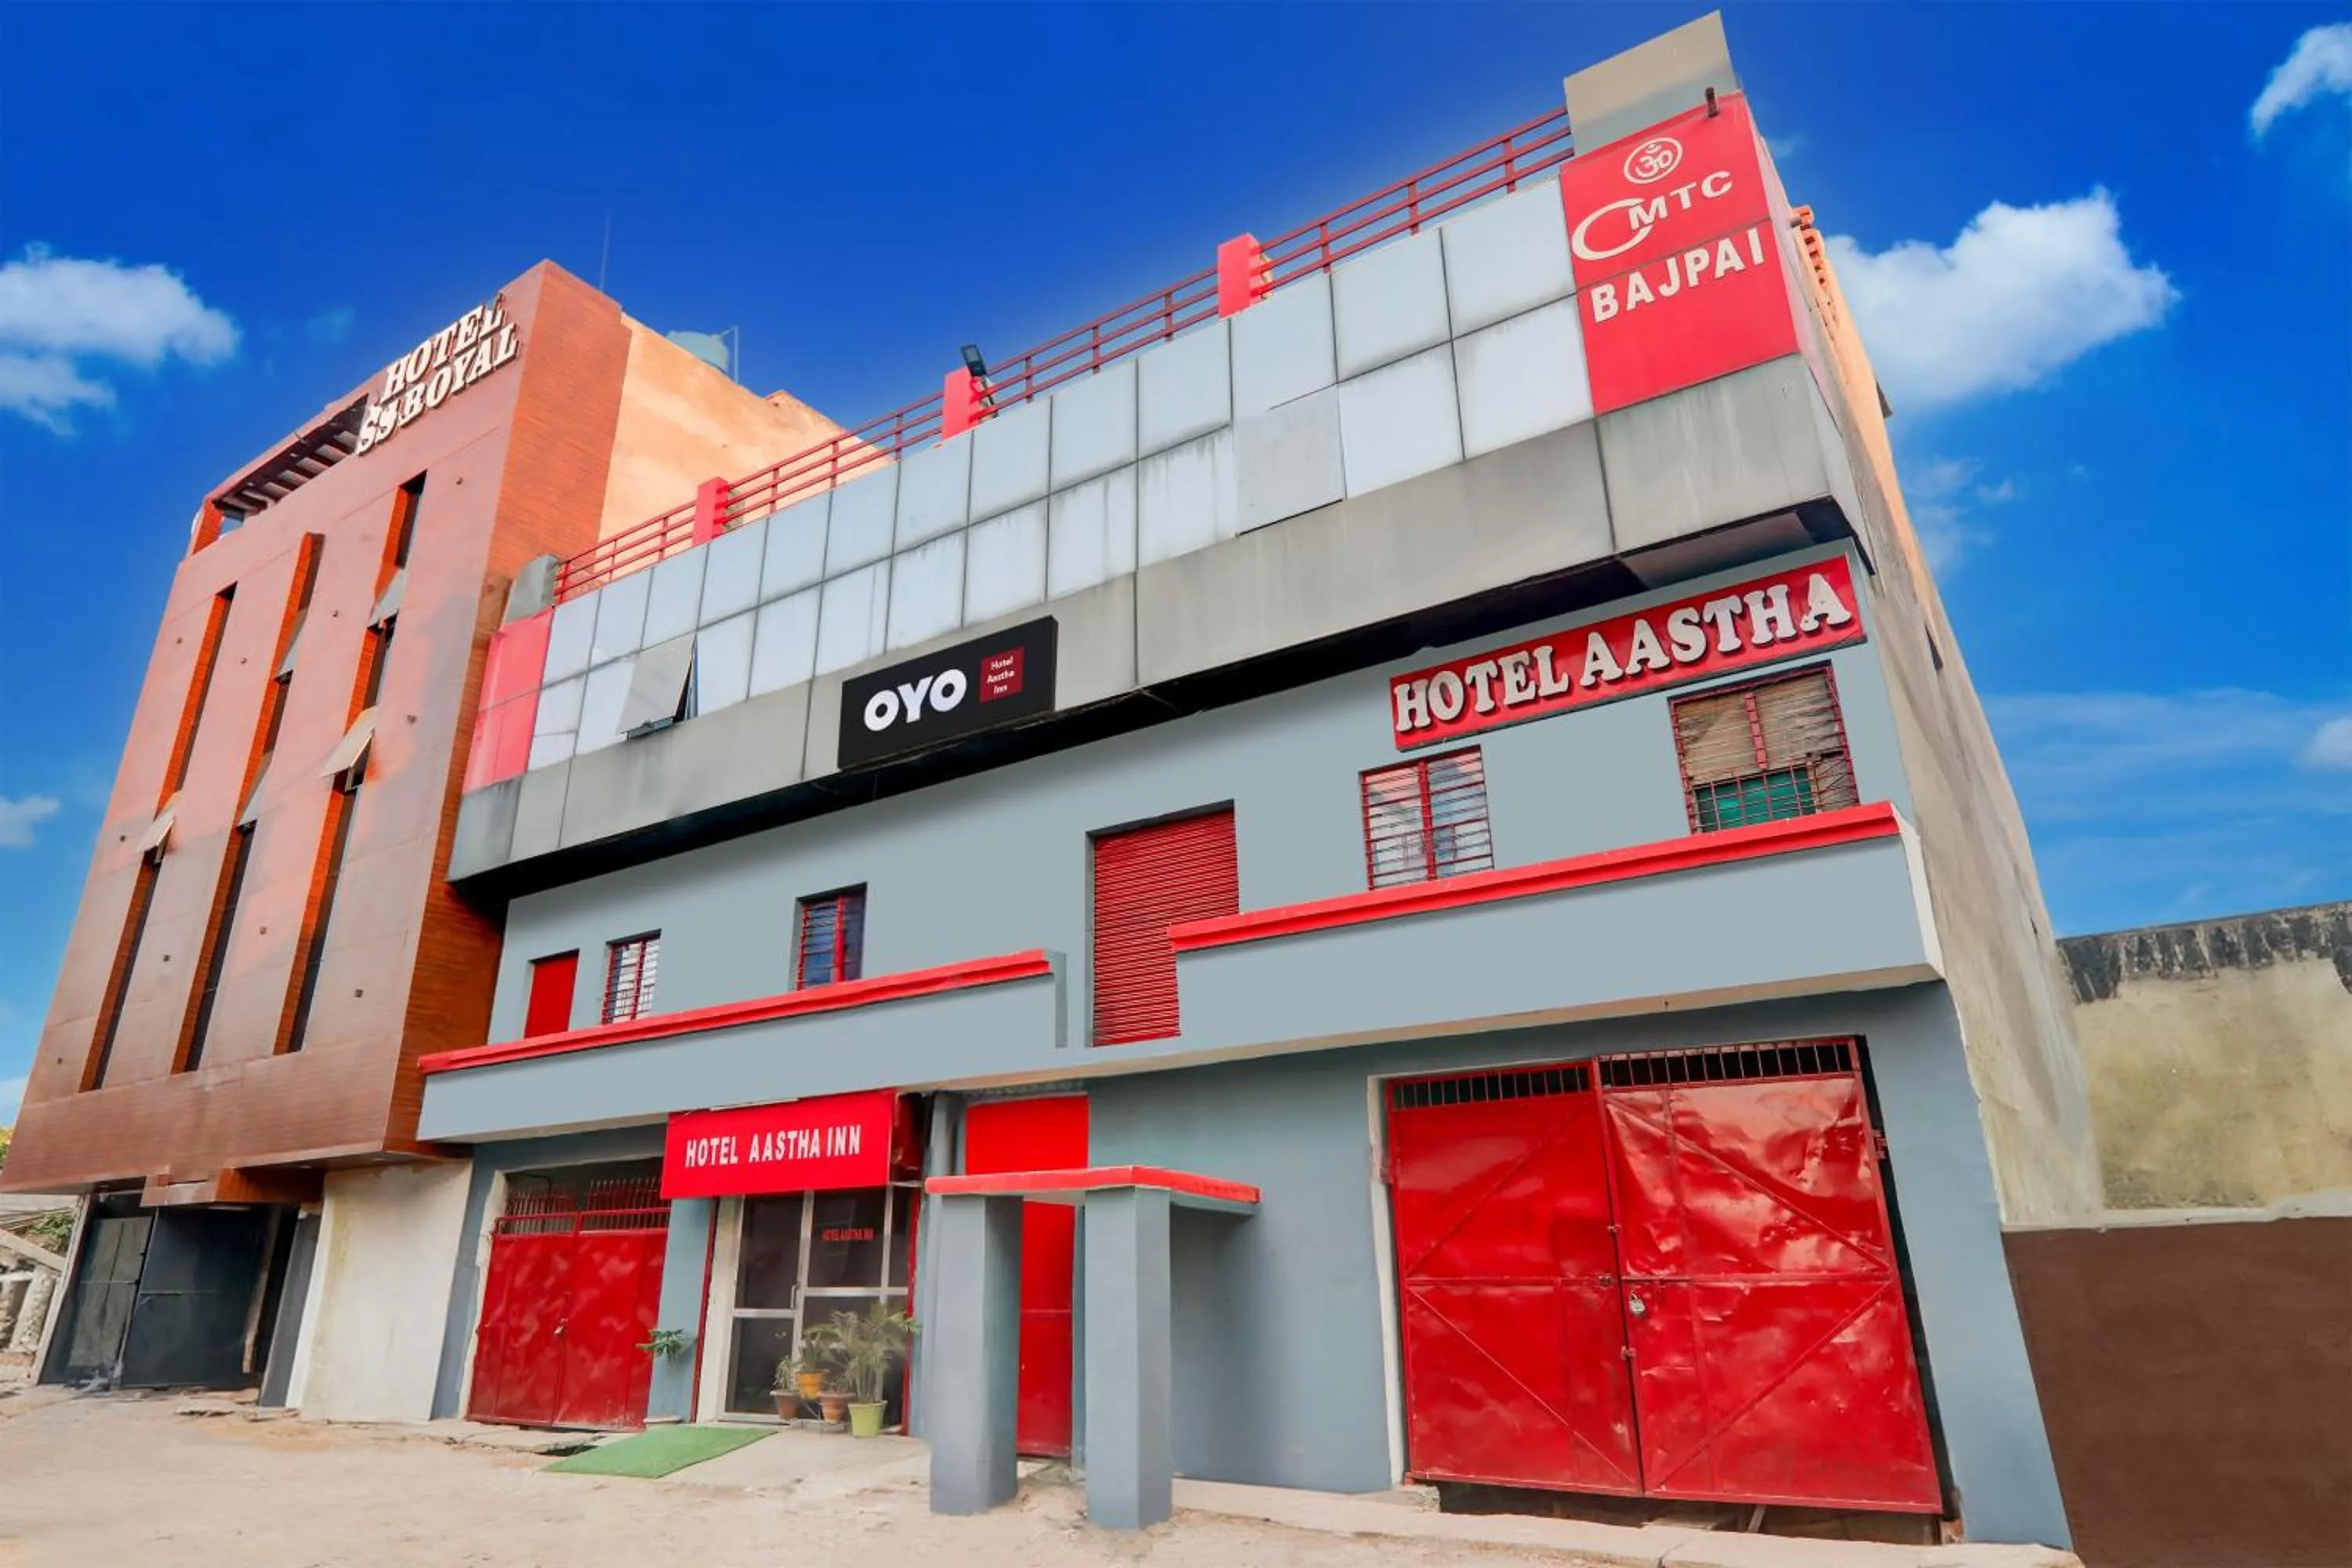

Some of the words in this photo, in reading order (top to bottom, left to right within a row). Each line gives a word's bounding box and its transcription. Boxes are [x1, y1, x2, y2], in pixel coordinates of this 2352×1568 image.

[1589, 227, 1766, 324] BAJPAI
[380, 295, 506, 403] HOTEL
[990, 655, 1014, 670] Hotel
[1392, 644, 1569, 732] HOTEL
[1579, 572, 1853, 687] AASTHA
[864, 668, 967, 732] OYO
[993, 684, 1008, 695] Inn
[684, 1136, 739, 1168] HOTEL
[748, 1127, 821, 1163] AASTHA
[826, 1123, 862, 1157] INN
